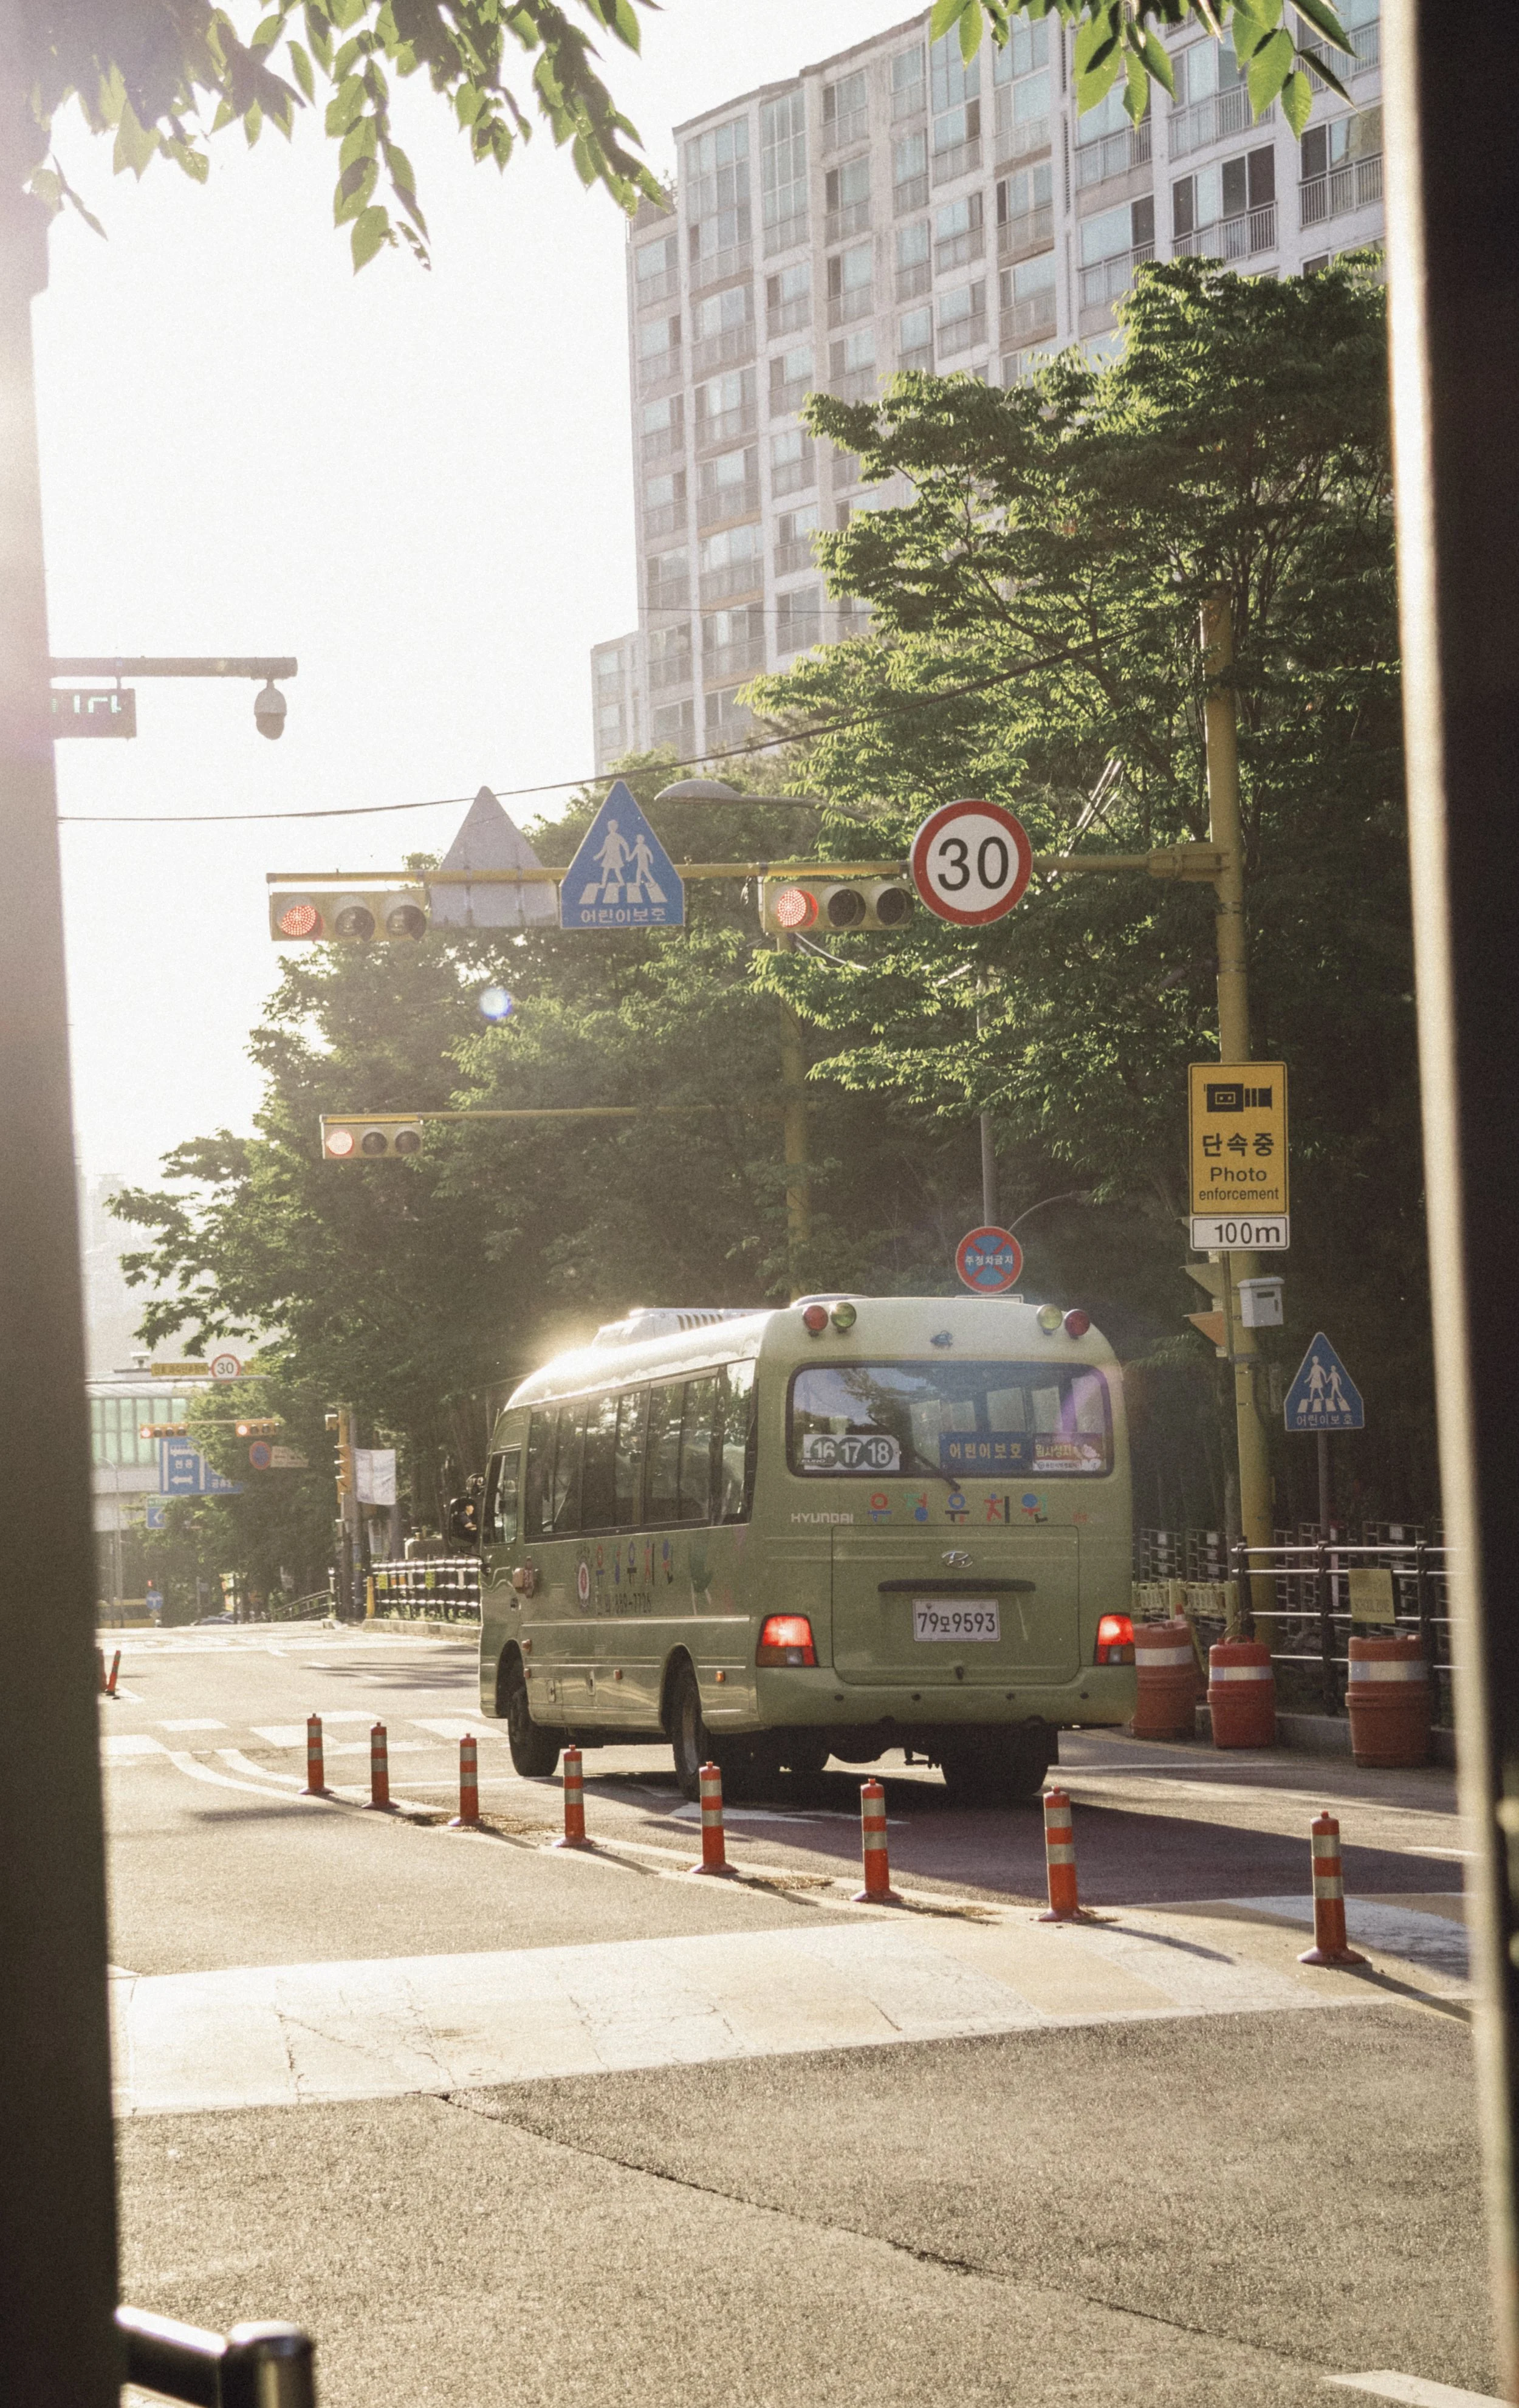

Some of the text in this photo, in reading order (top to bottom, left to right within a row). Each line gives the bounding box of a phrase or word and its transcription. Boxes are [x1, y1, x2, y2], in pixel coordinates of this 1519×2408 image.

[938, 837, 1009, 891] 30
[581, 908, 667, 924] 어린이보호
[1202, 1133, 1274, 1157] 단속중
[1210, 1167, 1267, 1182] Photo
[1199, 1187, 1279, 1201] enforcement
[1215, 1222, 1280, 1244] 100m
[965, 1255, 1013, 1266] 주정차금지
[218, 1362, 234, 1374] 30
[1297, 1414, 1353, 1427] 어린이보호
[814, 1441, 890, 1464] 16 17 18
[949, 1443, 1022, 1459] 어린이보호
[791, 1513, 854, 1523] HYUNDAI
[917, 1613, 995, 1633] 79모9593
